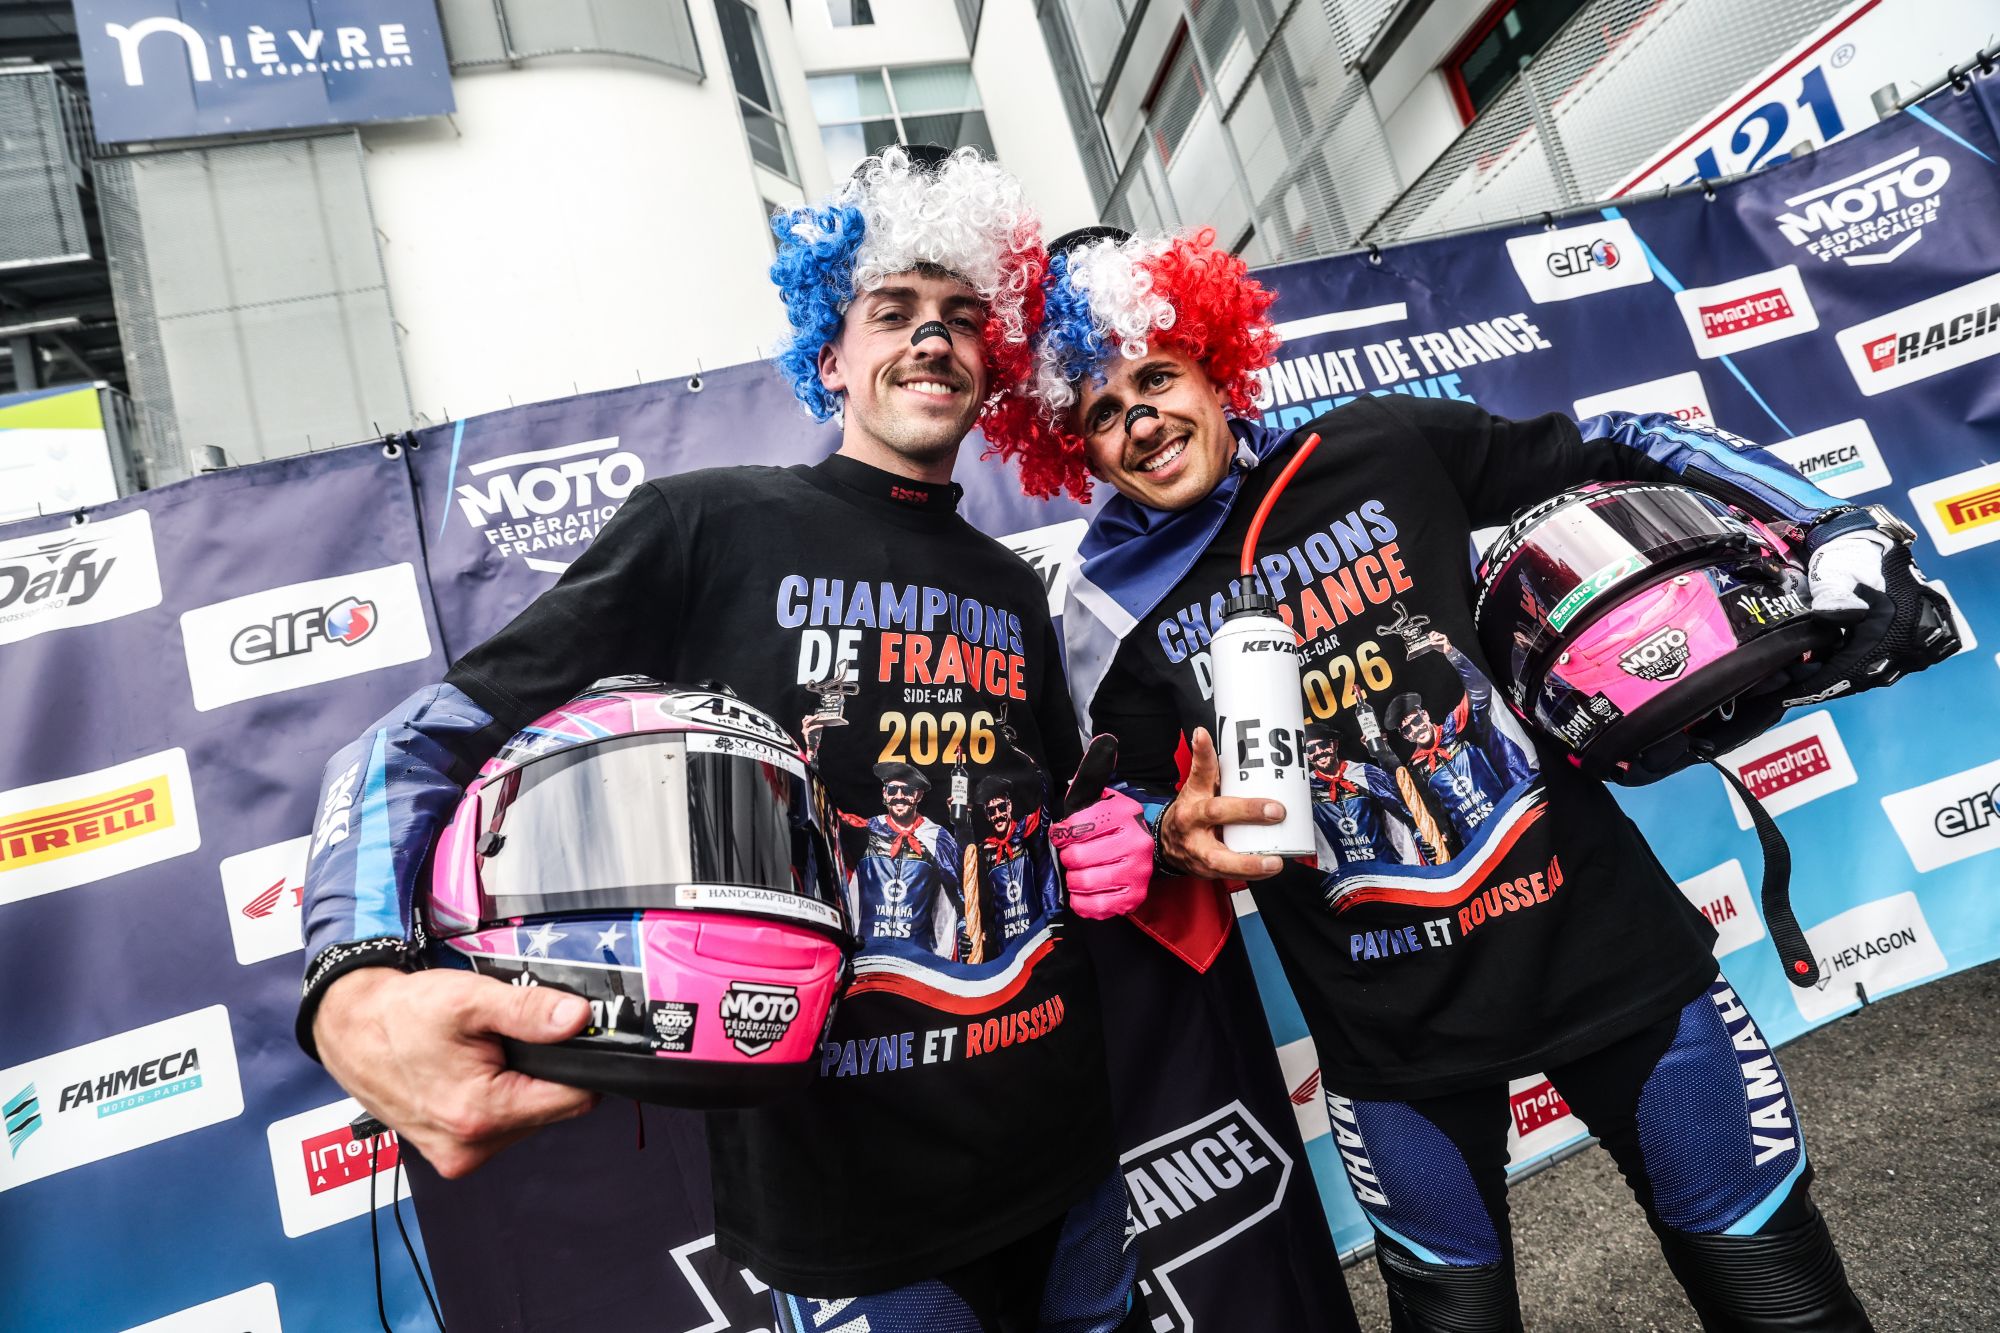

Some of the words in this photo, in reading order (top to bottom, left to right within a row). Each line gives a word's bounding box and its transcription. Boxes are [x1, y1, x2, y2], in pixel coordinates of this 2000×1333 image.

[1679, 65, 1845, 186] 21
[1775, 155, 1951, 246] MOTO
[1806, 194, 1940, 255] FÉDÉRATION
[1818, 209, 1938, 262] FRANÇAISE
[1546, 244, 1593, 277] elf
[1363, 338, 1421, 386] DE
[1408, 312, 1553, 375] FRANCE
[1872, 339, 1896, 360] GP
[1798, 444, 1861, 475] HMECA
[455, 451, 645, 528] MOTO
[484, 502, 625, 546] FÉDÉRATIO
[497, 521, 608, 558] FRANÇAI
[230, 607, 327, 666] elf
[776, 574, 1025, 657] CHAMPIONS
[1189, 651, 1213, 701] D
[1276, 541, 1414, 649] RANCE
[796, 629, 864, 685] DE
[878, 631, 1027, 701] FRANCE
[1298, 634, 1341, 668] DE-CAR
[1619, 629, 1687, 675] MOTO
[1638, 644, 1689, 678] FÉDÉRATION
[1645, 652, 1690, 680] FRANÇAISE
[903, 687, 963, 704] SIDE-CAR
[1302, 640, 1394, 726] 026
[690, 697, 789, 742] Arai
[877, 709, 997, 766] 2026
[734, 738, 783, 761] SCOTT
[1934, 790, 1991, 838] elf
[1339, 835, 1371, 847] YAMAHA
[709, 888, 796, 905] HANDCRAFTED
[797, 898, 827, 916] JOINTS
[875, 904, 913, 918] YAMAHA
[1003, 902, 1029, 920] YAMAHA
[1350, 926, 1423, 962] PAYNE
[1423, 917, 1453, 948] ET
[1457, 854, 1565, 937] ROUSSEAU
[1831, 926, 1917, 972] HEXAGON
[652, 1012, 694, 1028] MOTO
[719, 992, 799, 1023] MOTO
[724, 1019, 788, 1033] FÉDÉRATION
[726, 1028, 783, 1041] FRANÇAISE
[820, 1031, 914, 1078] PAYNE
[922, 1026, 958, 1065] ET
[966, 994, 1065, 1059] ROUSSEAU
[59, 1047, 201, 1113] FAHMECA
[1712, 973, 1796, 1166] YAMAH
[101, 1078, 198, 1115] MOTOR-PARTS
[1325, 1090, 1388, 1206] MAHA
[1124, 1123, 1272, 1235] ANCE
